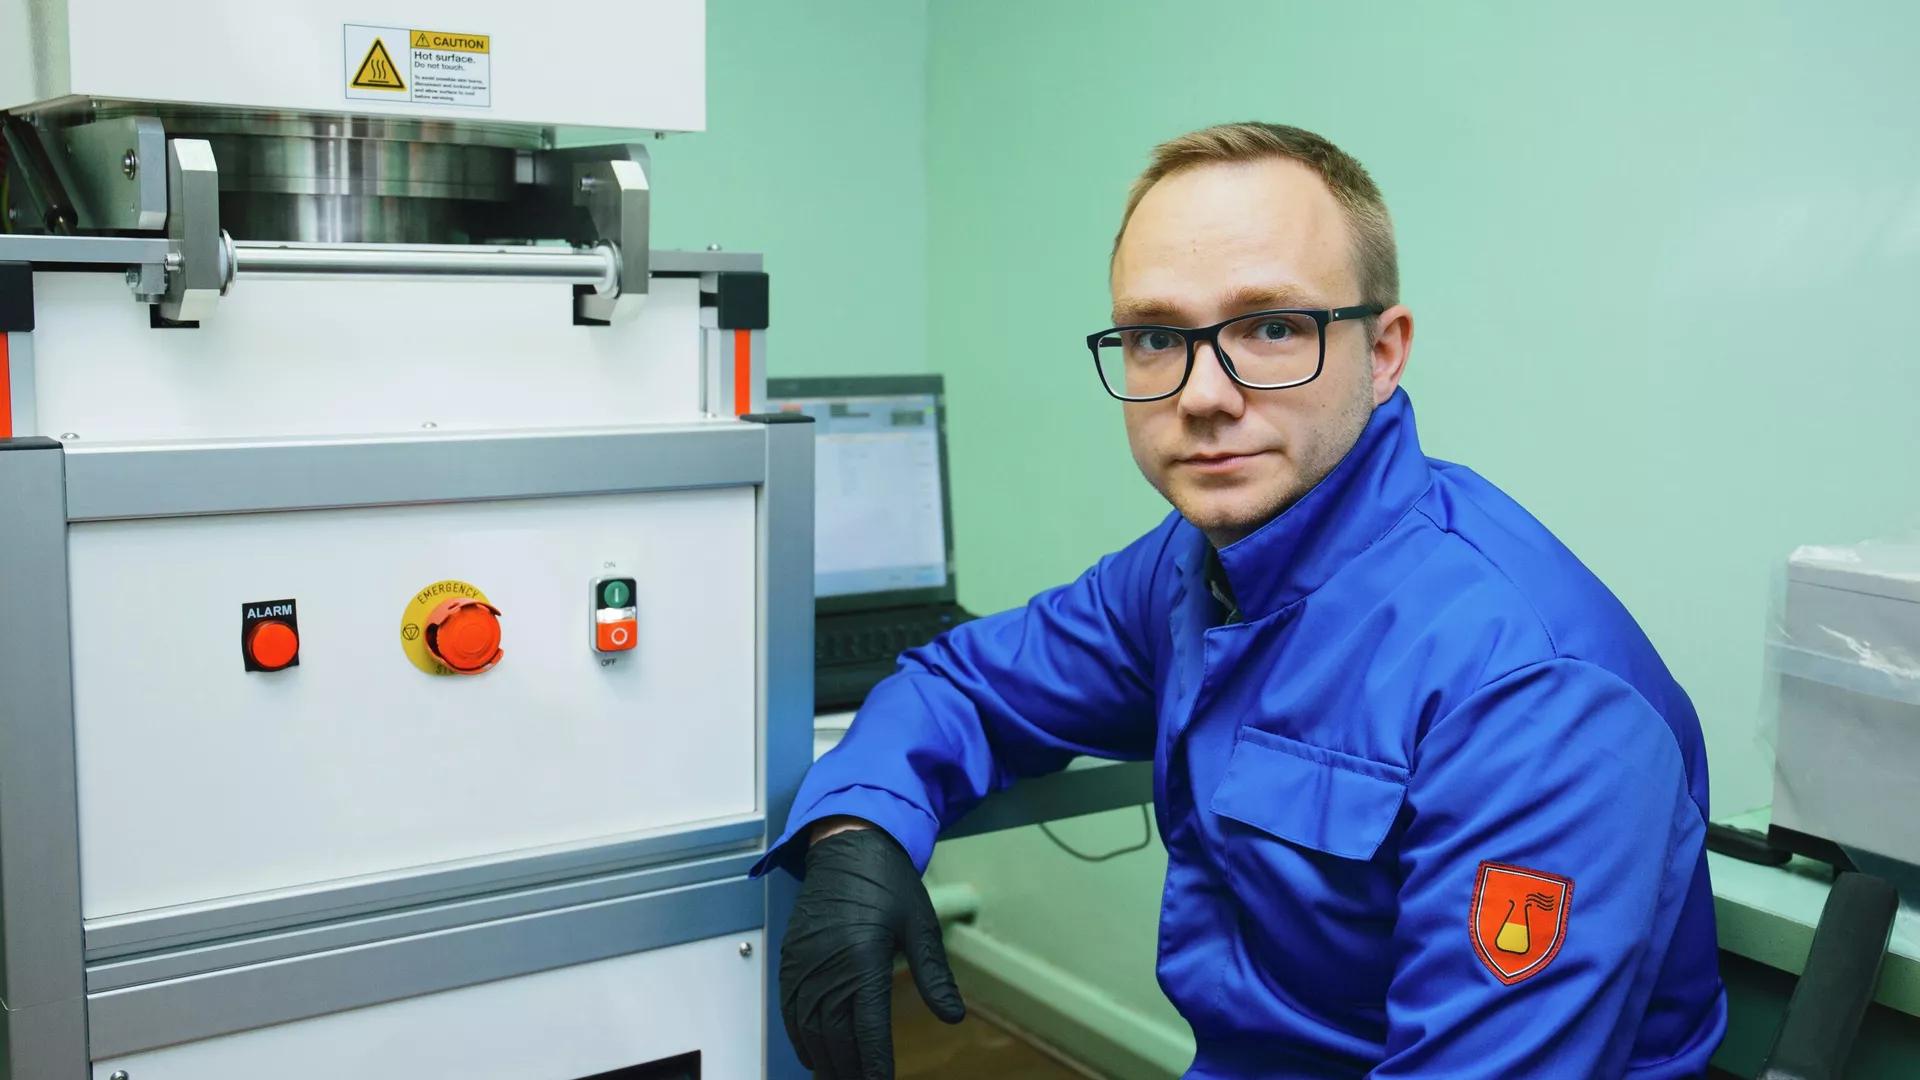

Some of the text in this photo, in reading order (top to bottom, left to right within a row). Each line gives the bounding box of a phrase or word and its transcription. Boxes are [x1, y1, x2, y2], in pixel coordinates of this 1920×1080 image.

[433, 37, 484, 49] CAUTION
[414, 51, 476, 64] Hot surface.
[603, 561, 616, 569] ON
[417, 583, 481, 604] EMERGENCY
[247, 604, 292, 619] ALARM
[601, 658, 617, 667] OFF
